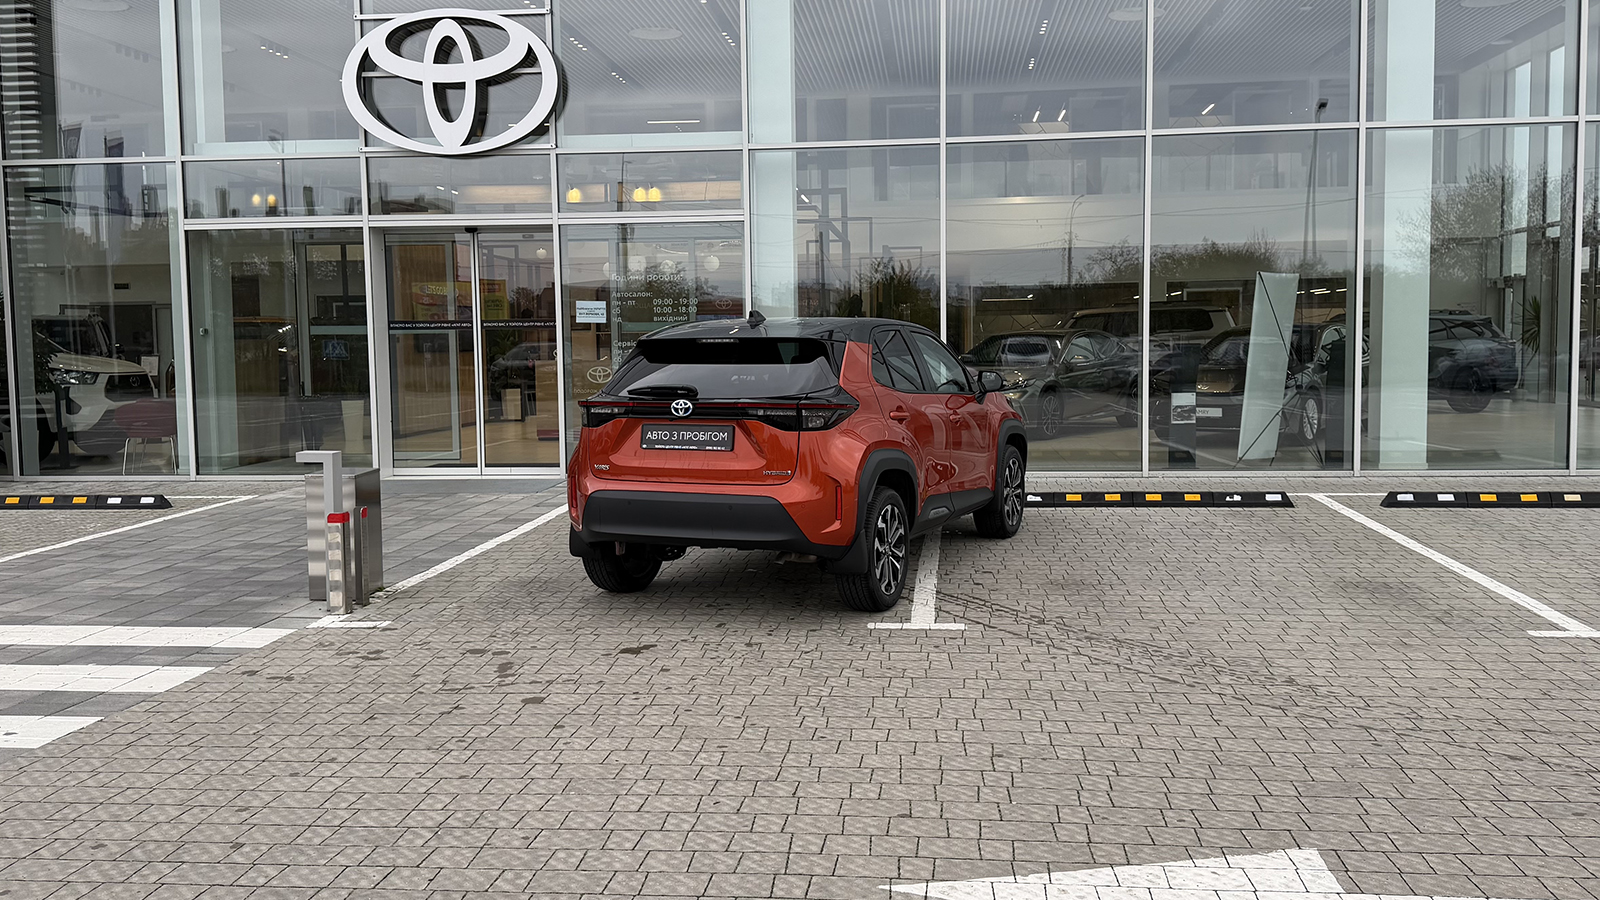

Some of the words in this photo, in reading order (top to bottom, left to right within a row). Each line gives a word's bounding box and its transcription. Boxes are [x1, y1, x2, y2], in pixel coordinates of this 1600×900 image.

[612, 273, 645, 282] Години
[647, 273, 683, 283] роботи:
[612, 306, 621, 314] сб
[645, 431, 670, 440] АВТО
[672, 431, 678, 440] З
[680, 431, 728, 441] ПРОБІГОМ
